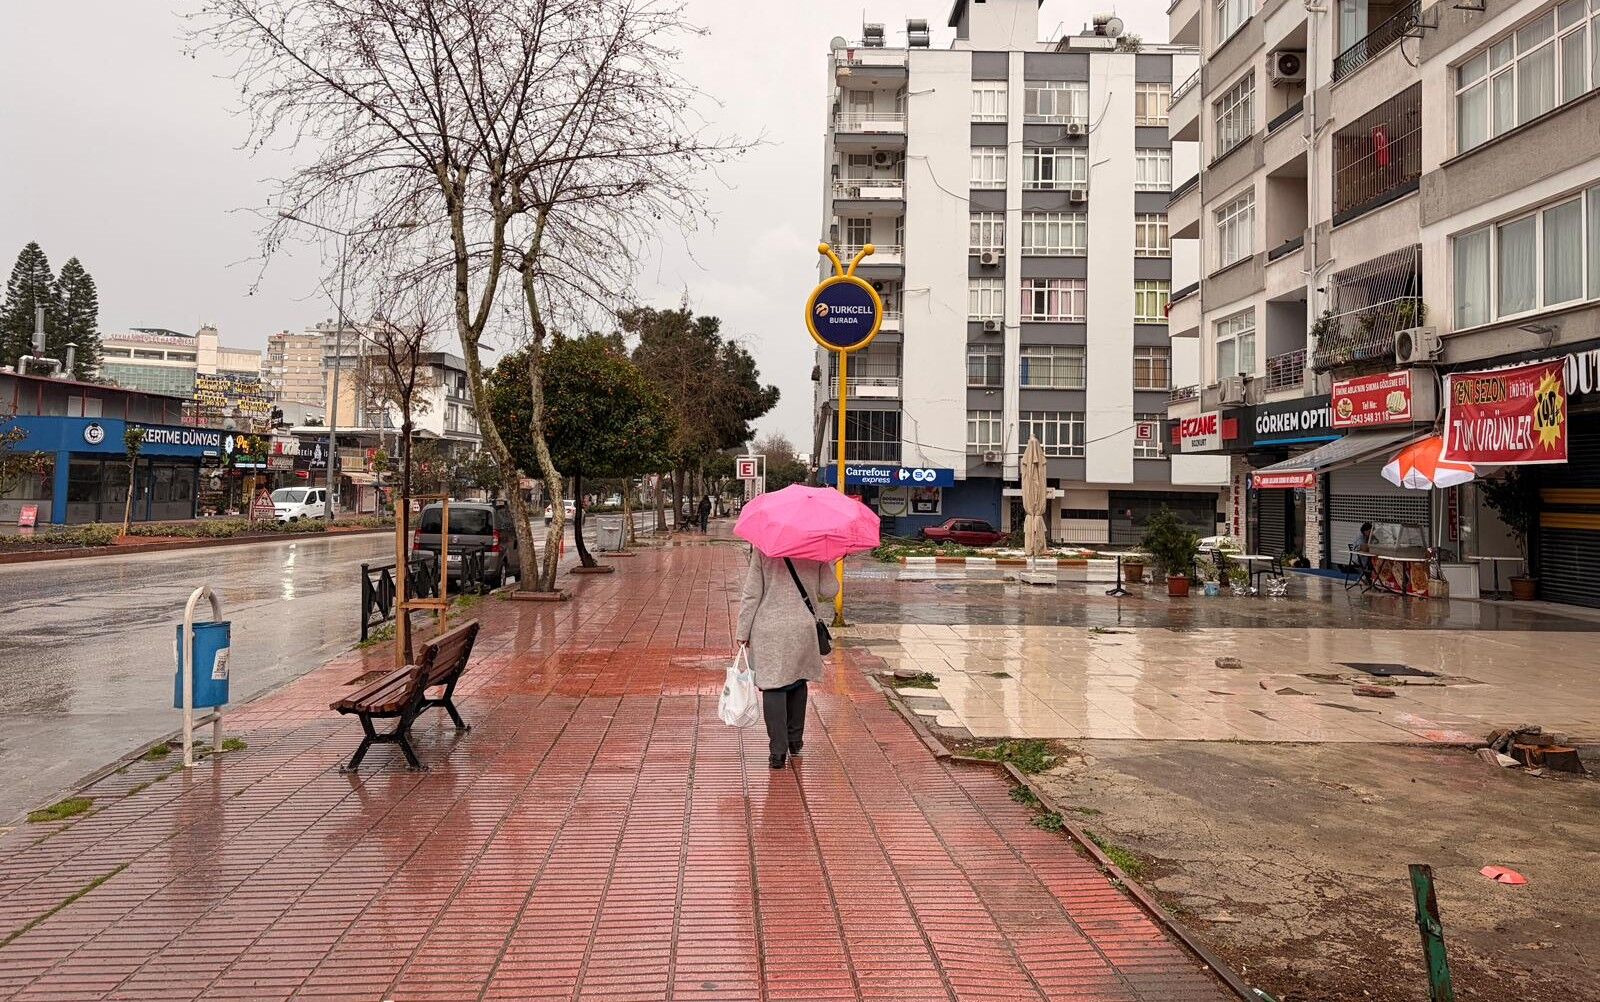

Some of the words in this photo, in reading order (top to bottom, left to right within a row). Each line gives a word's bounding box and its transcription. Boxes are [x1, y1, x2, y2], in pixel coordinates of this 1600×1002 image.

[830, 306, 873, 314] TURKCELL
[1475, 376, 1507, 404] SEZON
[1510, 378, 1534, 398] İNDİRİM
[1182, 415, 1217, 438] ECZANE
[1256, 411, 1299, 433] GÖRKEM
[1476, 410, 1534, 451] ÜRÜNLER
[182, 429, 220, 447] DÜNYASI
[1140, 427, 1149, 436] E
[742, 463, 752, 475] E
[846, 467, 890, 476] Carrefour
